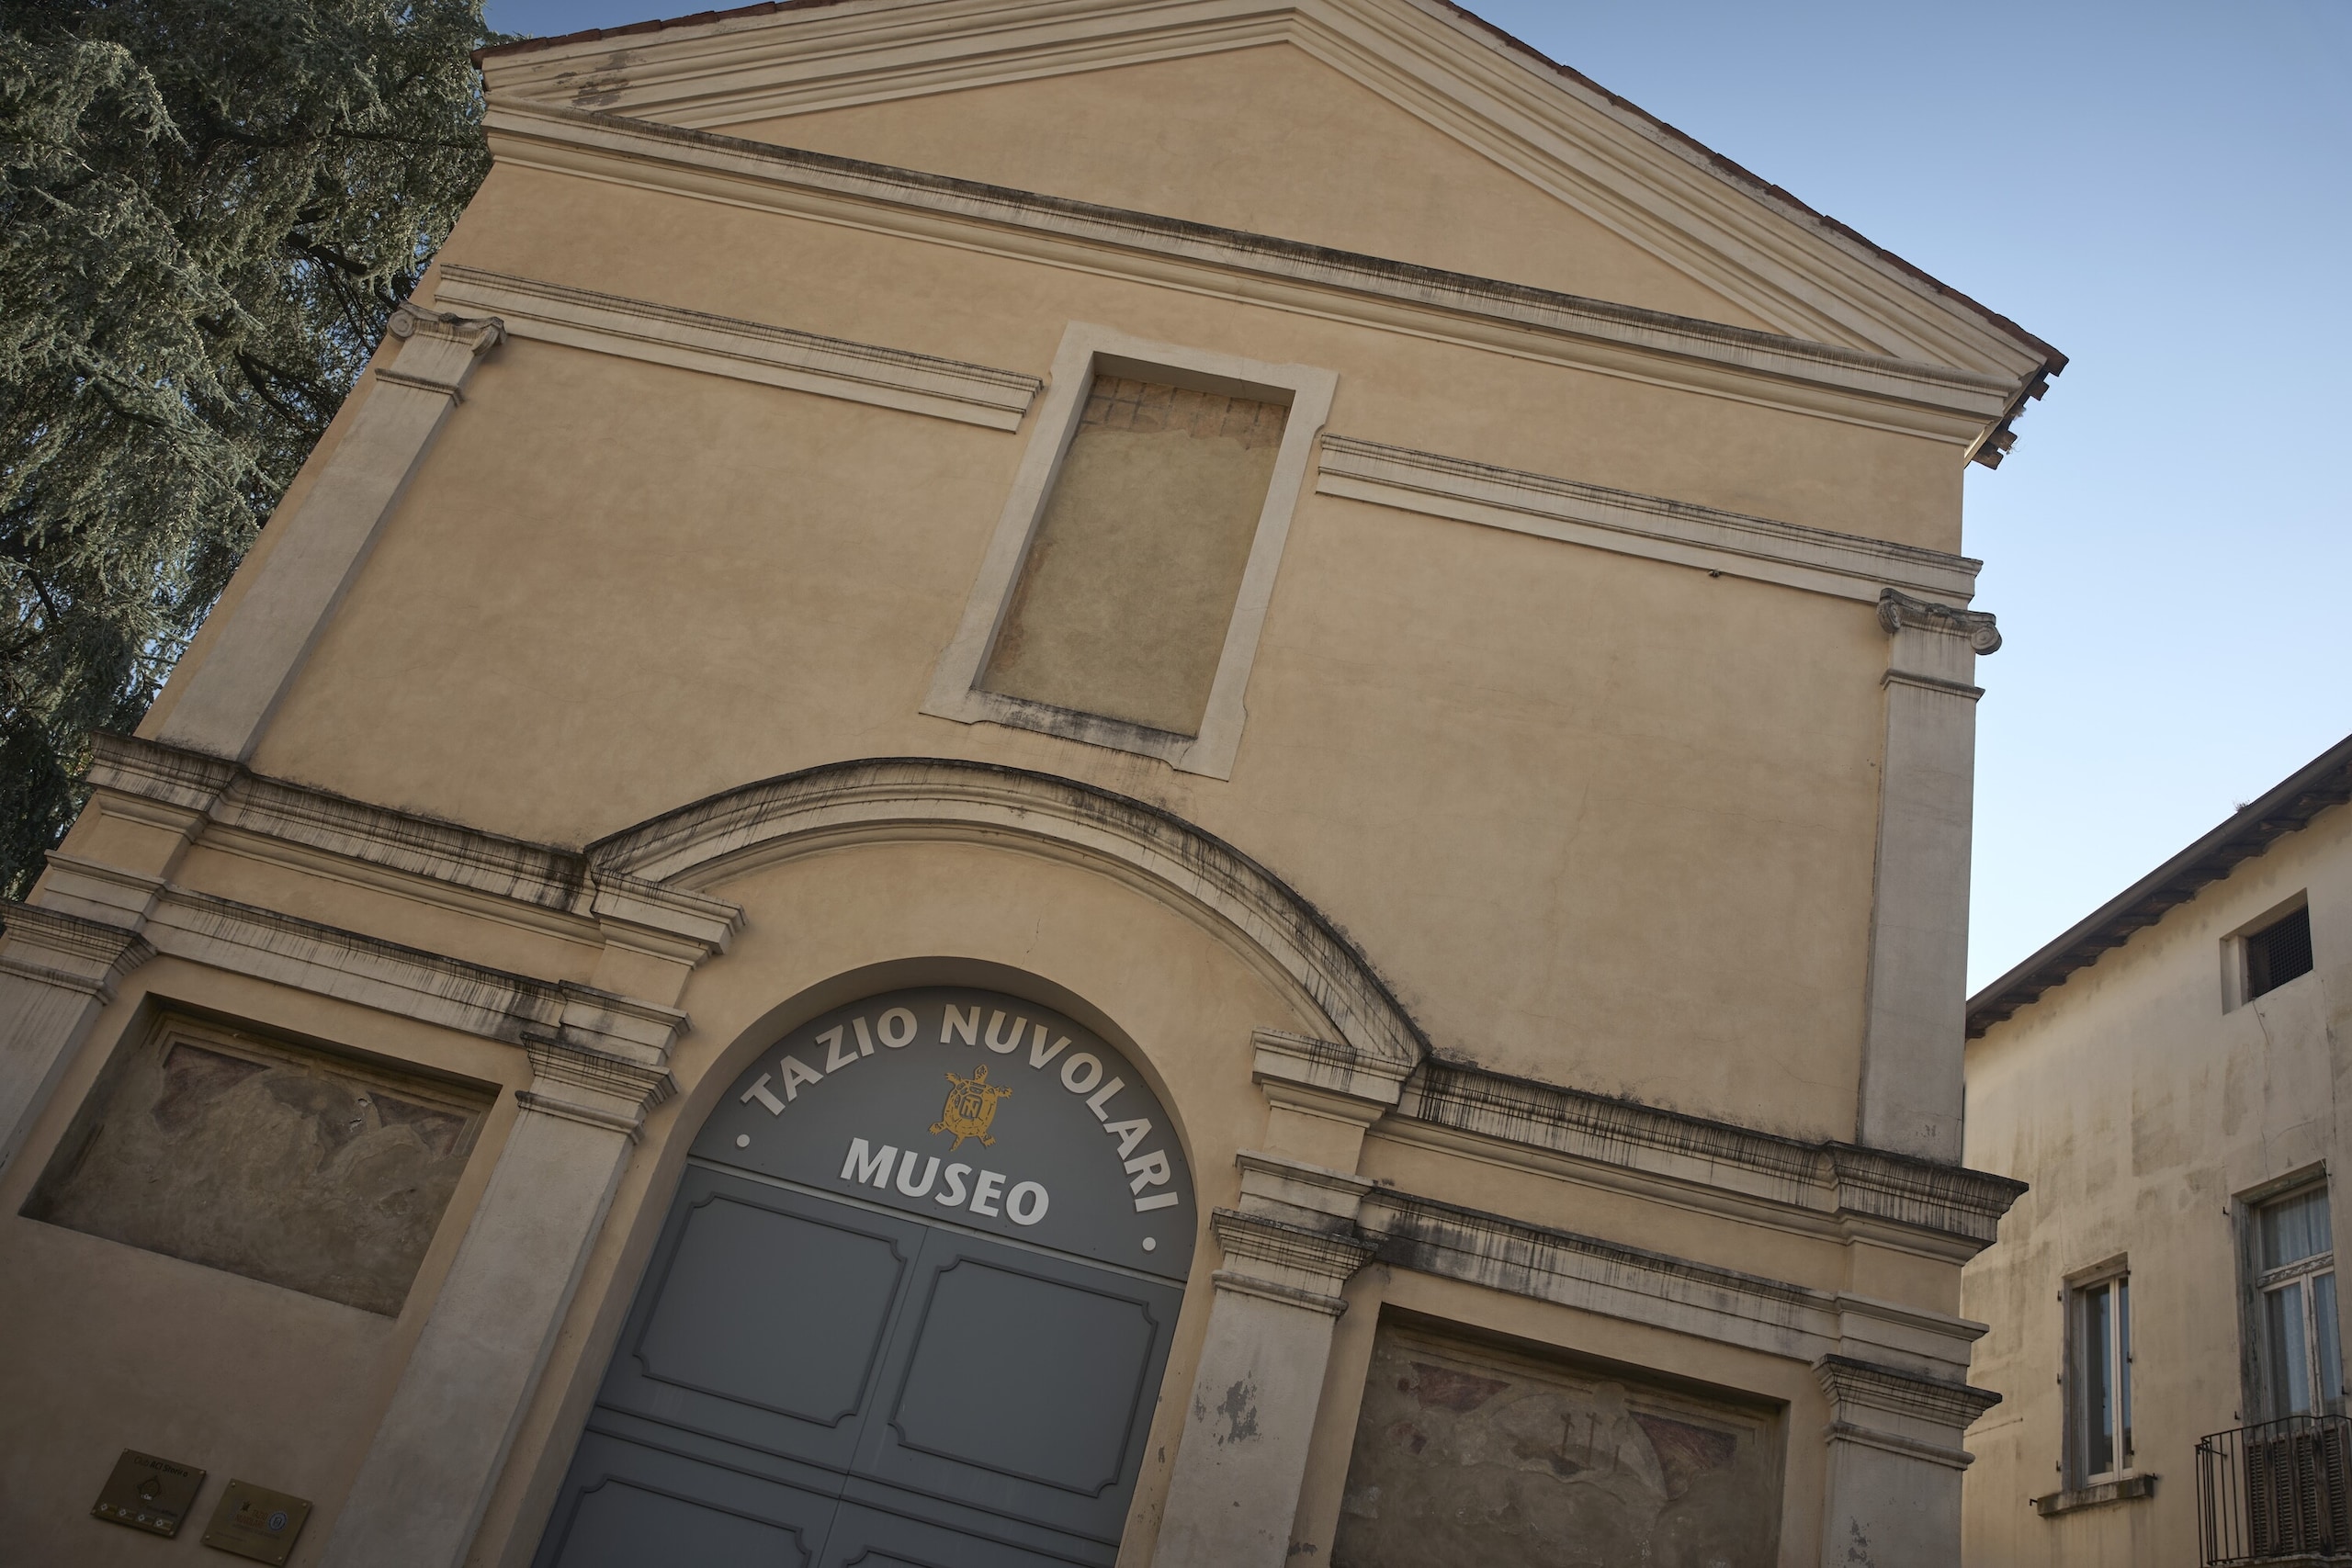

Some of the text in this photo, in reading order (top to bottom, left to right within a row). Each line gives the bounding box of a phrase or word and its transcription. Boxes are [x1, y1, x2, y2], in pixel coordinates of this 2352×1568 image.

[740, 1004, 1179, 1213] TAZIO NUVOLARI
[840, 1137, 1050, 1226] MUSEO
[149, 1461, 164, 1471] ACI
